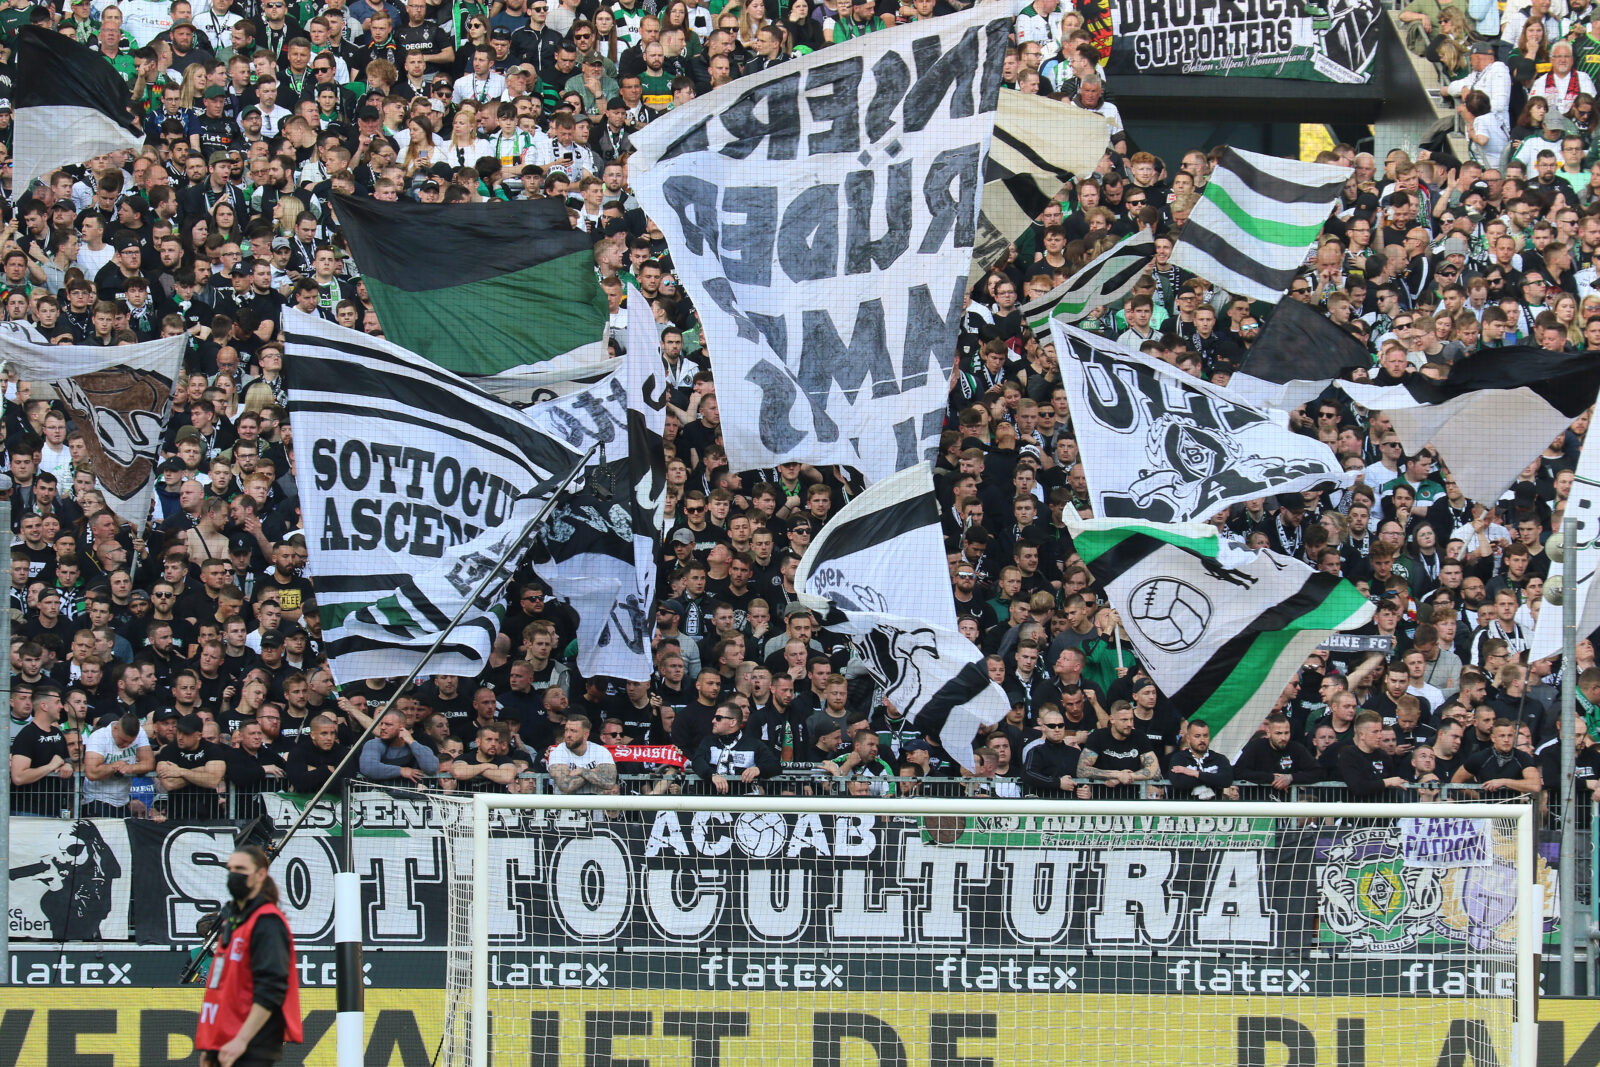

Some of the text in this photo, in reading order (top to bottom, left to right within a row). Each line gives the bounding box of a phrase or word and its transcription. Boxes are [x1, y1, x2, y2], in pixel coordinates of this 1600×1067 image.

[1118, 0, 1306, 35] DROPKICK
[405, 42, 433, 51] DEGIRO
[1134, 18, 1293, 69] SUPPORTERS
[1368, 637, 1388, 649] FC
[11, 954, 132, 985] latex
[490, 954, 609, 986] latex
[701, 955, 844, 988] flatex
[935, 957, 1078, 989] flatex
[1167, 959, 1311, 992] flatex
[200, 1002, 219, 1025] TV
